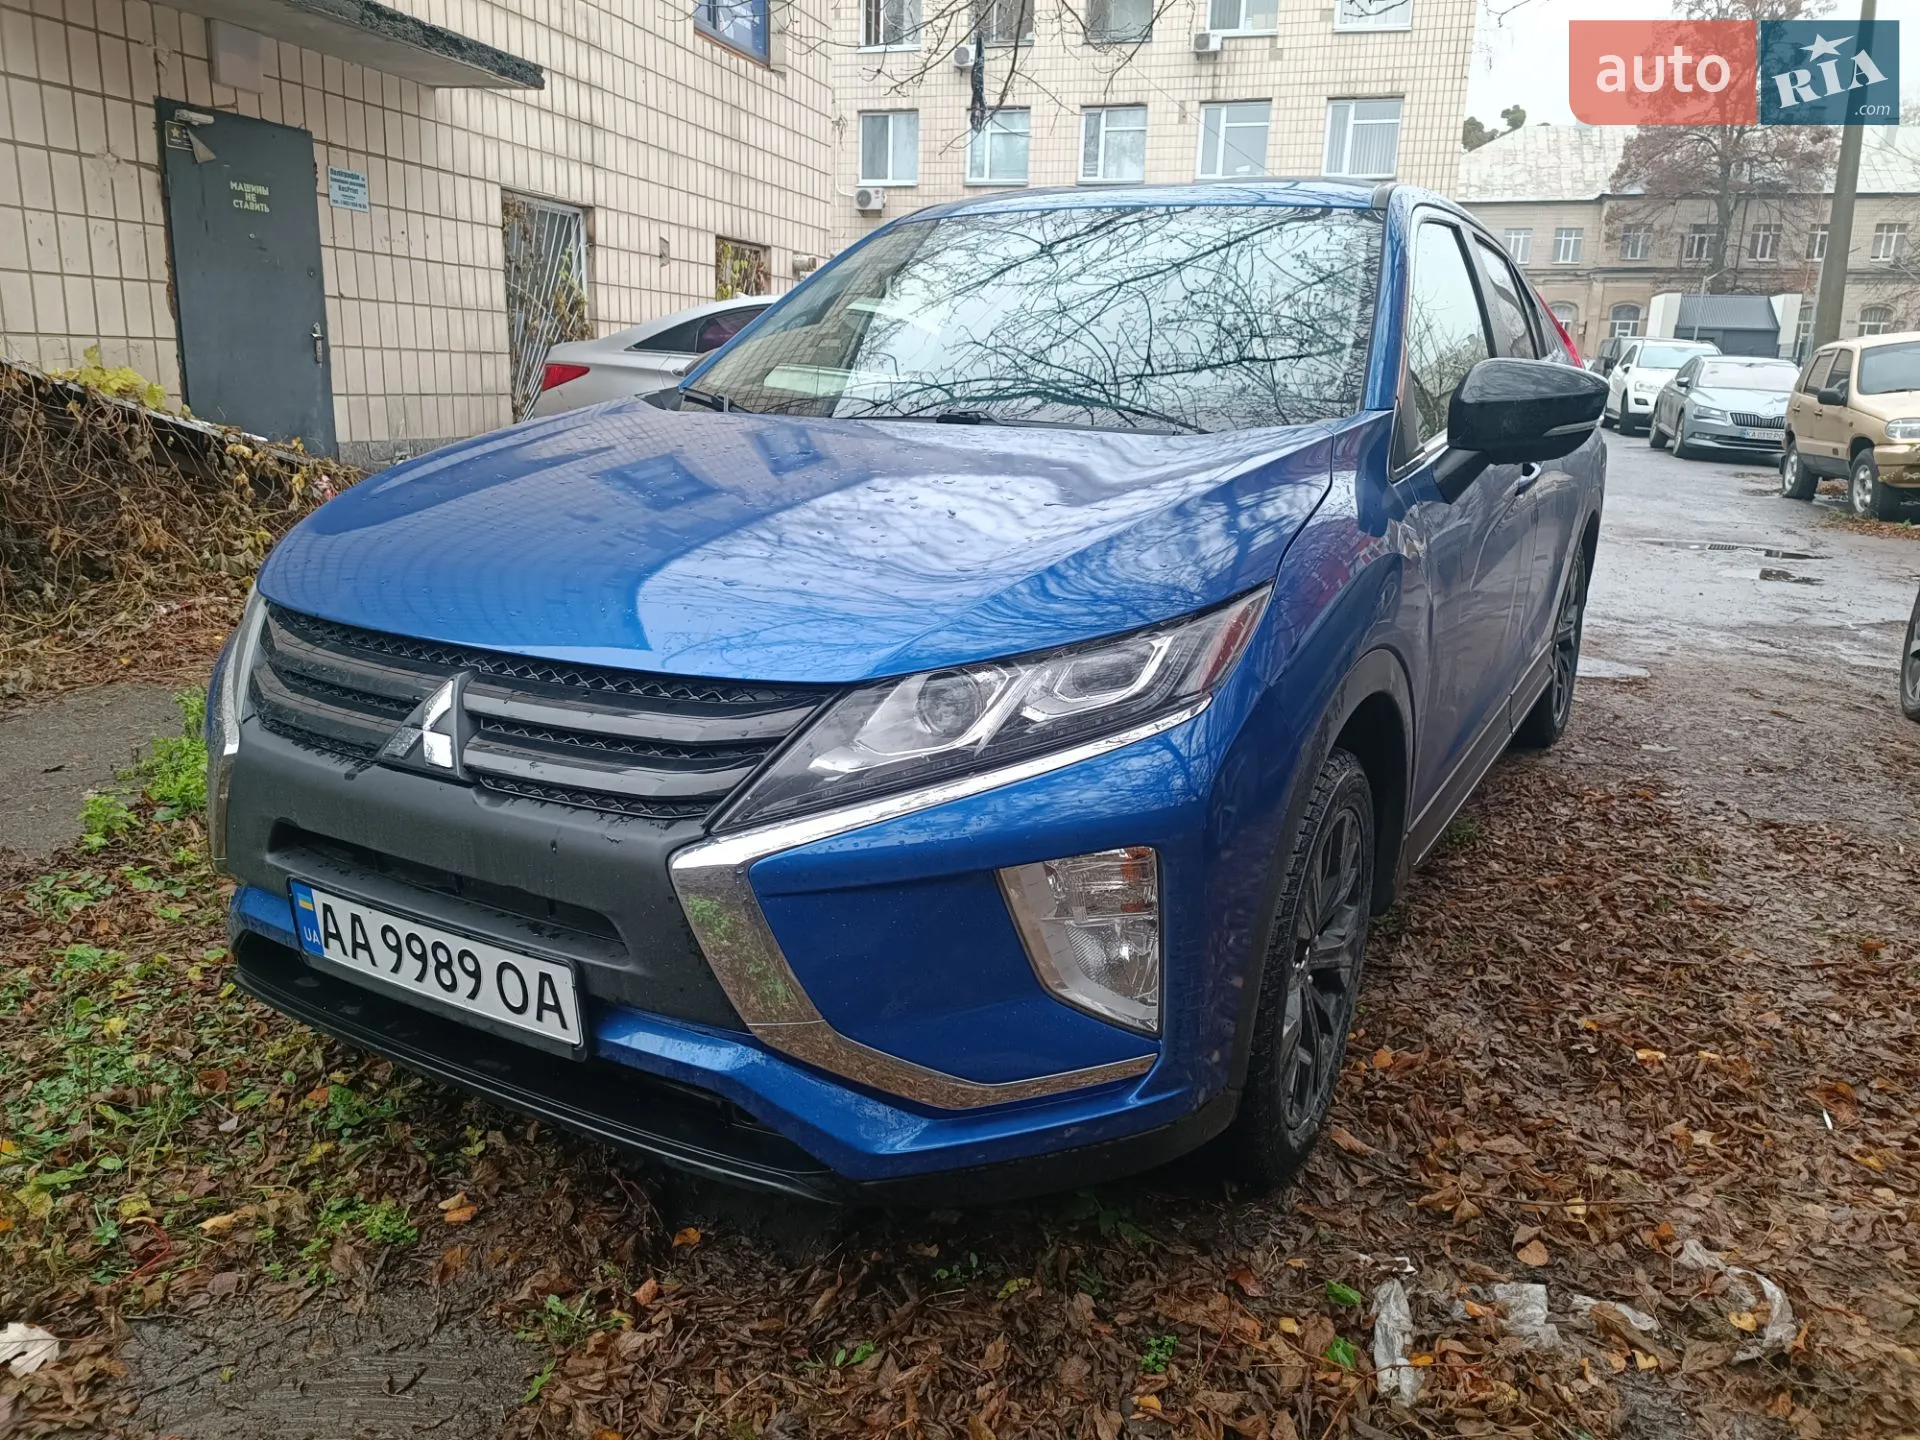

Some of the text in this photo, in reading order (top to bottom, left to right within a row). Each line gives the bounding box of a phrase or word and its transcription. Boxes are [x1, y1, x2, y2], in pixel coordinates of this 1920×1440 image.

[230, 181, 270, 196] МАШИНЫ
[245, 192, 257, 202] НЕ
[232, 199, 270, 213] СТАВИТЬ
[303, 925, 321, 945] UA
[322, 902, 570, 1031] AA 9989 OA
